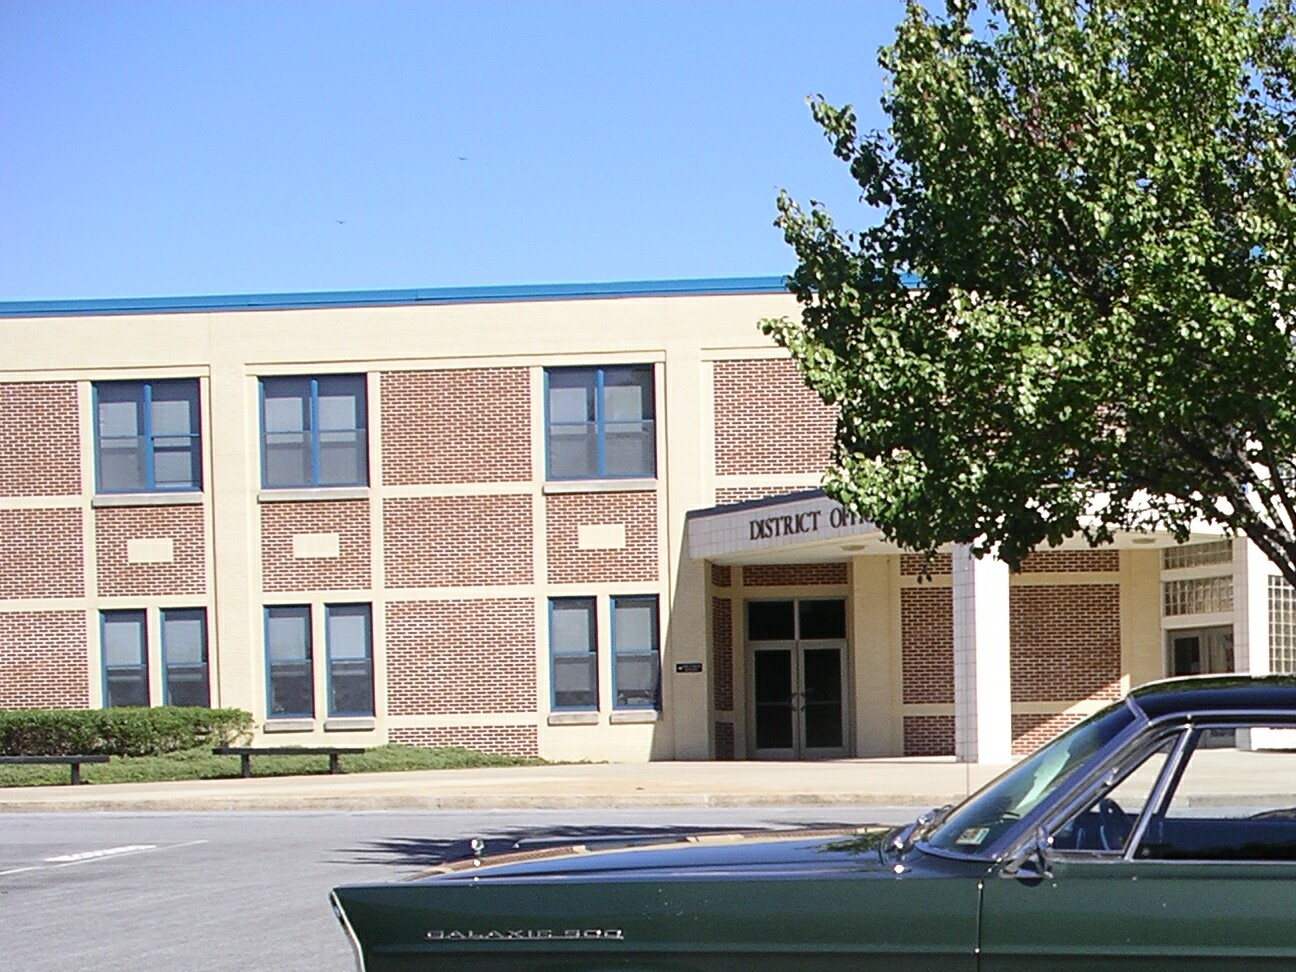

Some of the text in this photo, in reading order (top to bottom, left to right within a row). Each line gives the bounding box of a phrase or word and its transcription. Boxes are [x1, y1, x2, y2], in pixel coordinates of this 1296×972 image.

[749, 510, 821, 540] DISTRICT
[425, 929, 625, 940] GALAXIE 500
